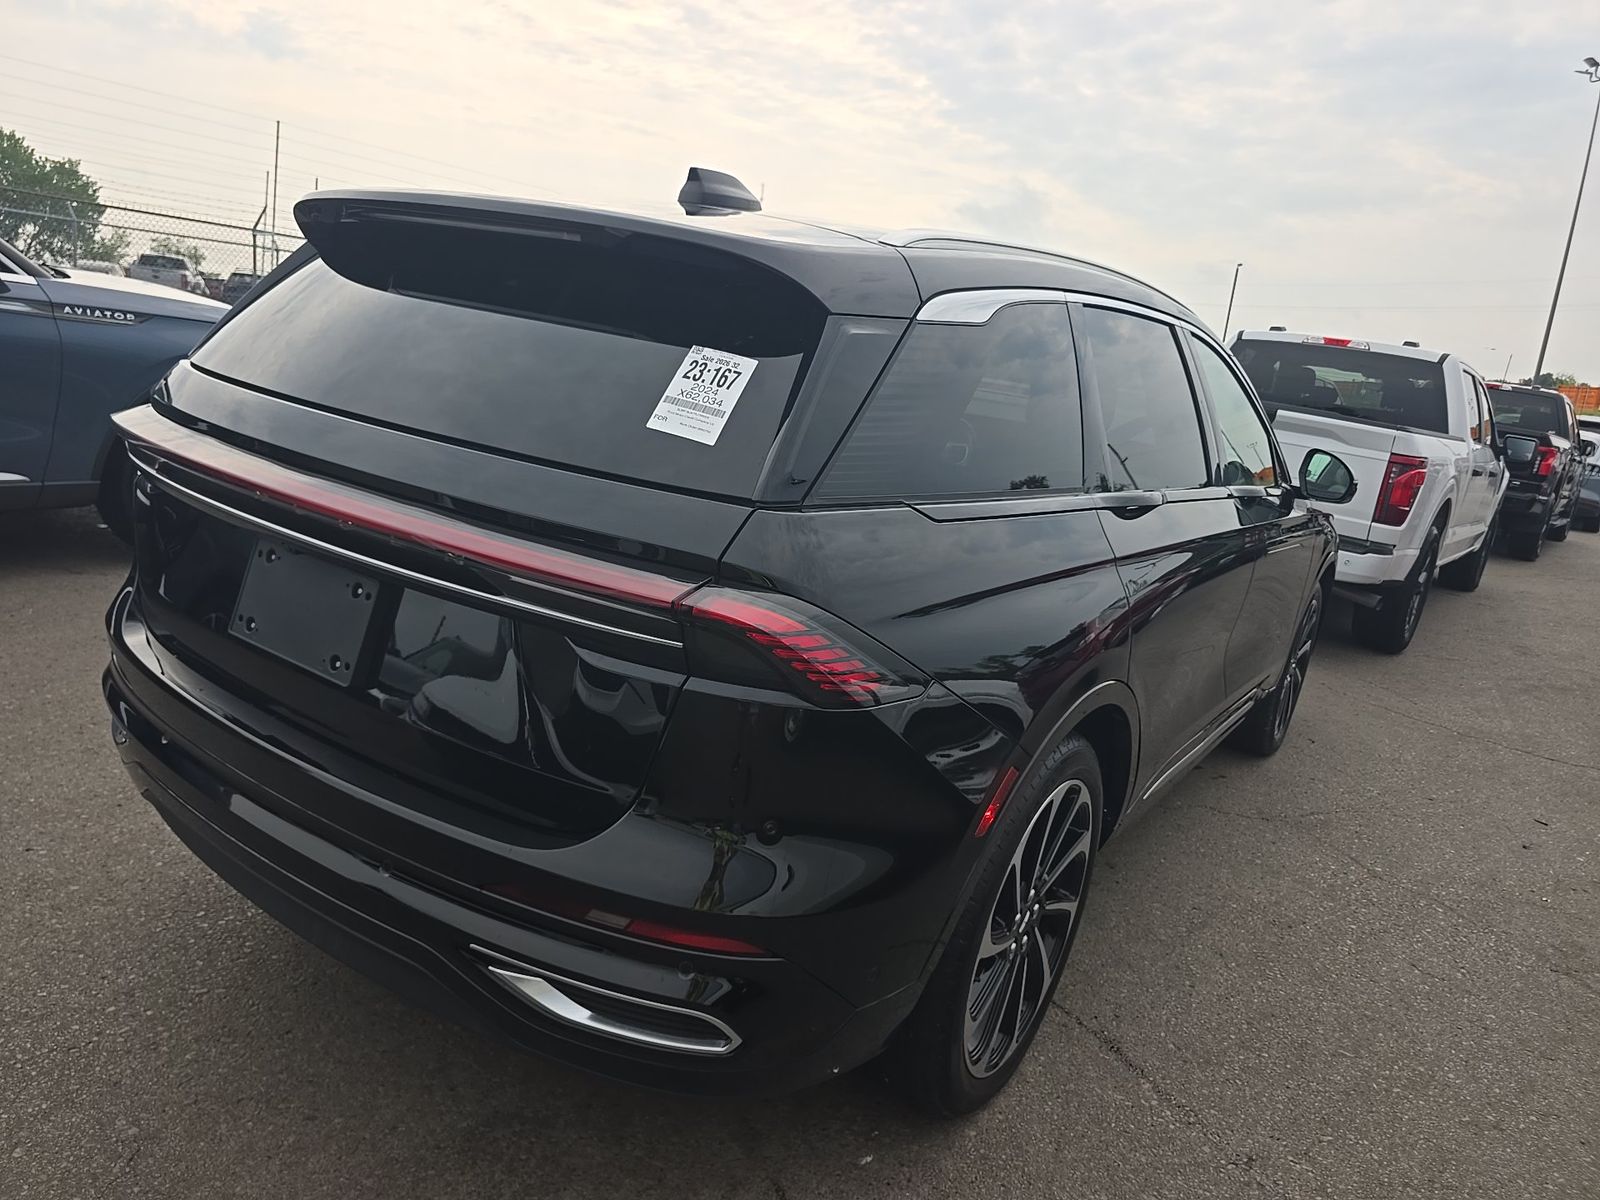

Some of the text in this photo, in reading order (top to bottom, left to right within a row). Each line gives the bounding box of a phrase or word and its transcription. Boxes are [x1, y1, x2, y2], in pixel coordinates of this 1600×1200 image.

[63, 305, 135, 320] AVIATOR
[701, 354, 714, 363] Sale
[682, 359, 742, 390] 23:167
[691, 383, 719, 396] 2024
[677, 388, 724, 408] X62,034
